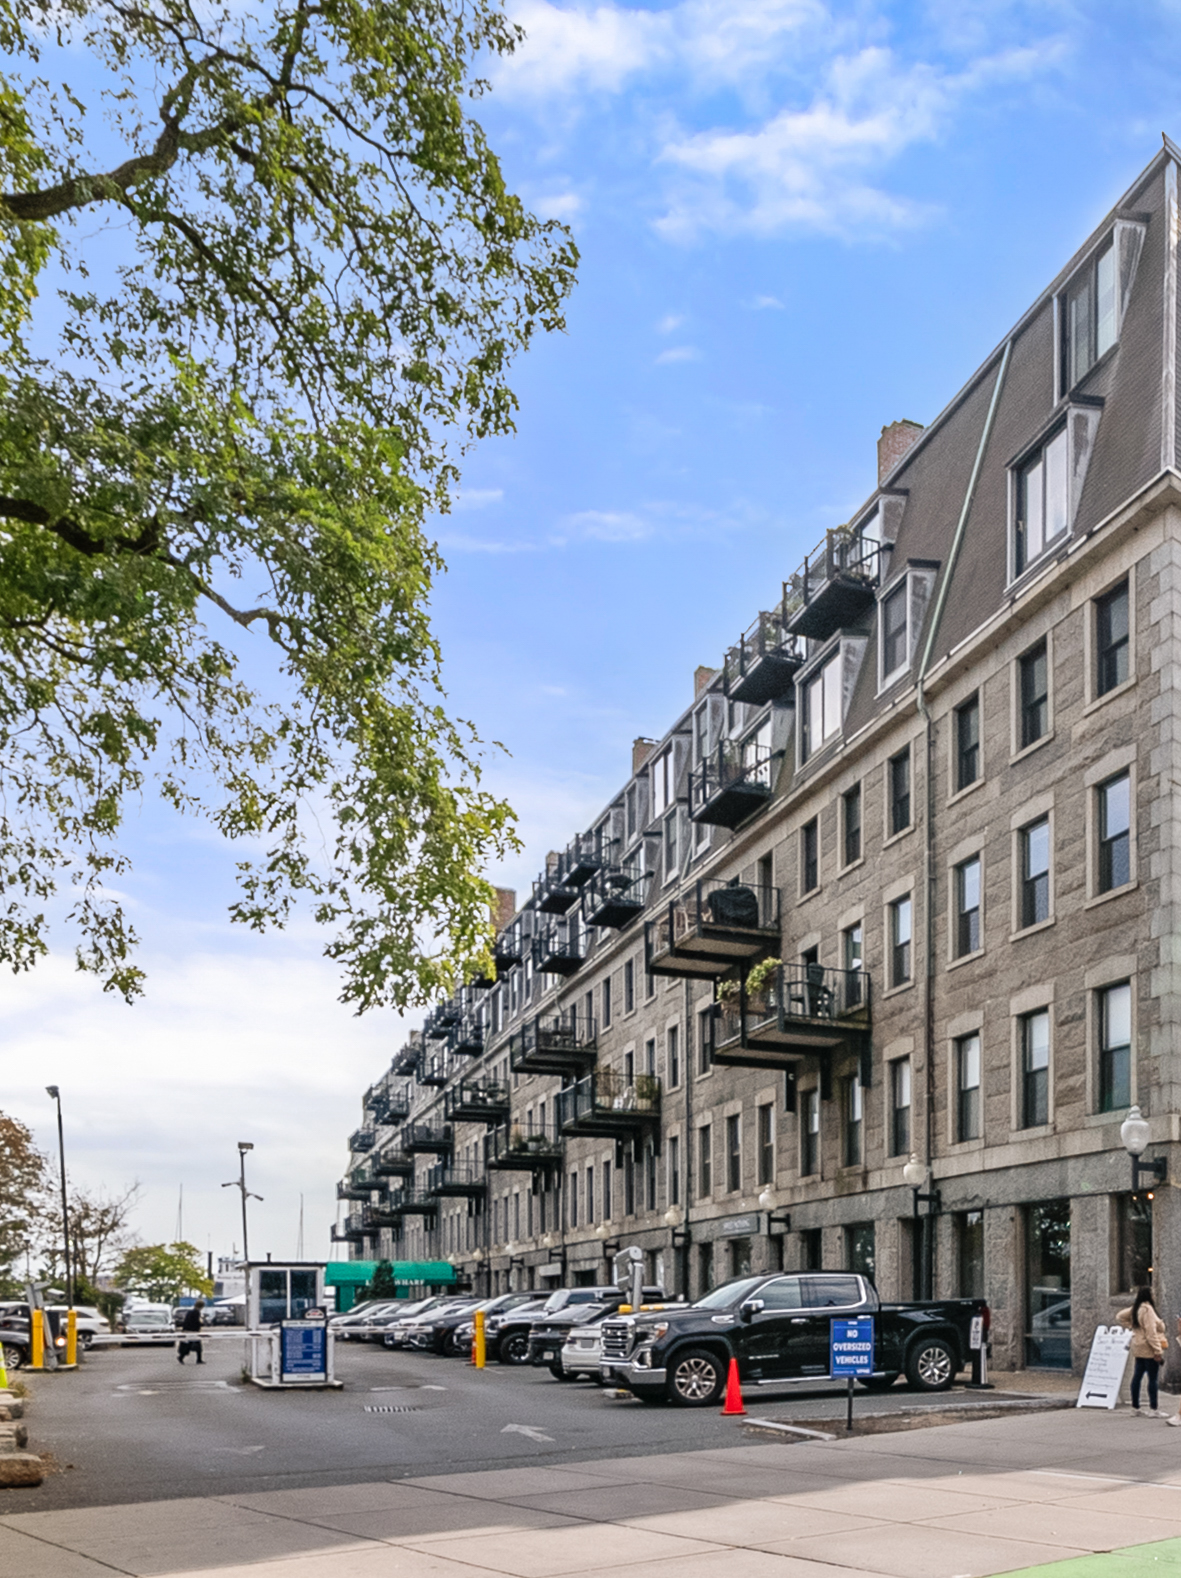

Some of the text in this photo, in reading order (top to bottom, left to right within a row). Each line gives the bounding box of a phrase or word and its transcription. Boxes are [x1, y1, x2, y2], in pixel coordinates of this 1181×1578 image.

[846, 1329, 859, 1338] NO
[832, 1342, 872, 1351] OVERSIZED
[835, 1355, 869, 1364] VEHICLES
